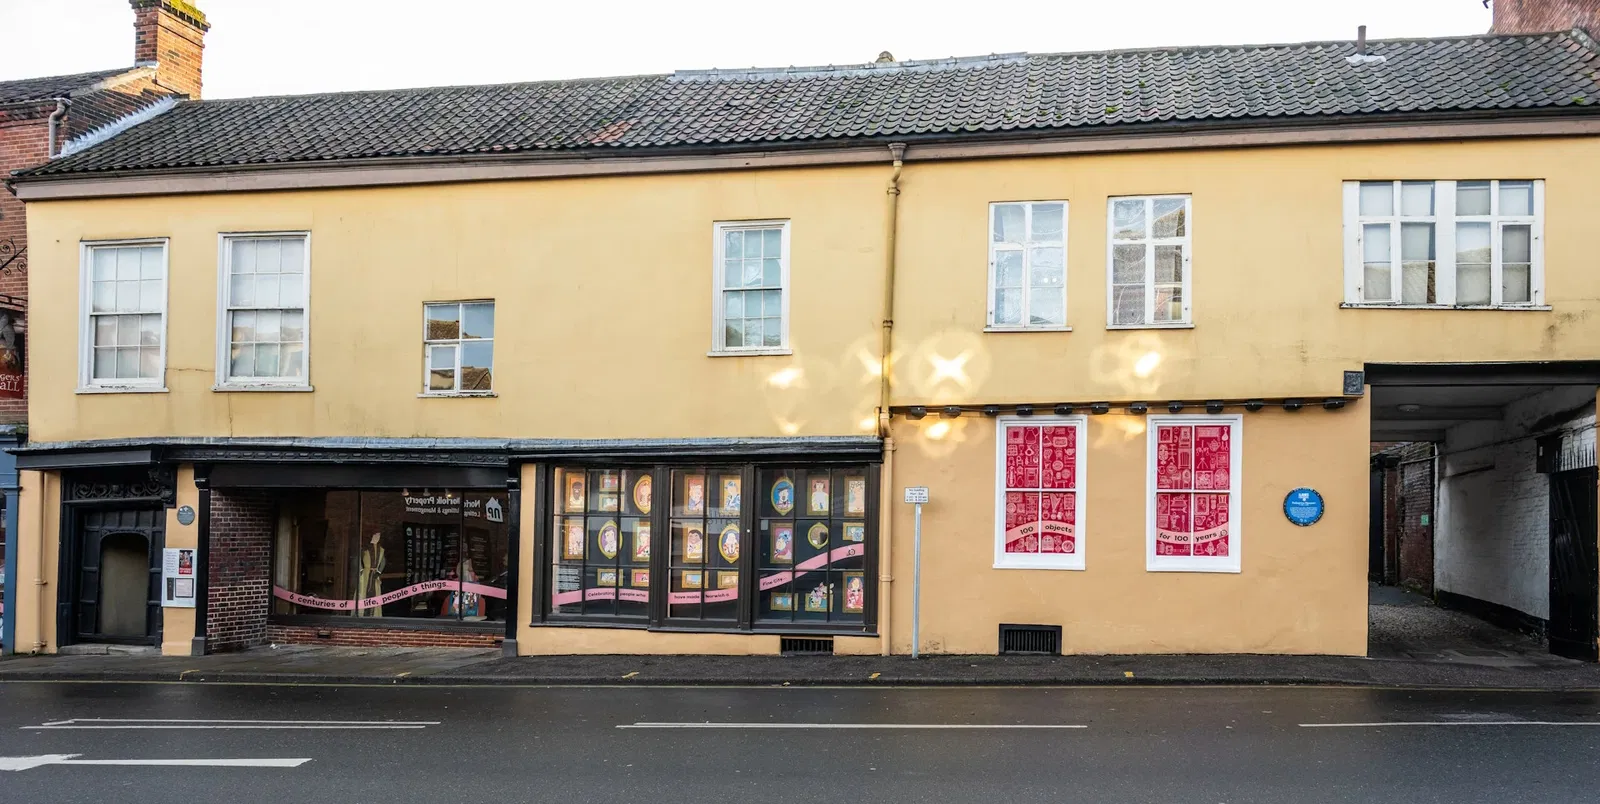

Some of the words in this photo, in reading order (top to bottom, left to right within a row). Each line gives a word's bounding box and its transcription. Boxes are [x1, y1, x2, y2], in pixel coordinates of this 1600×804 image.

[1020, 526, 1034, 534] 100
[1045, 524, 1072, 533] objects
[1196, 532, 1217, 541] years
[298, 597, 336, 607] centuries
[382, 590, 408, 603] people
